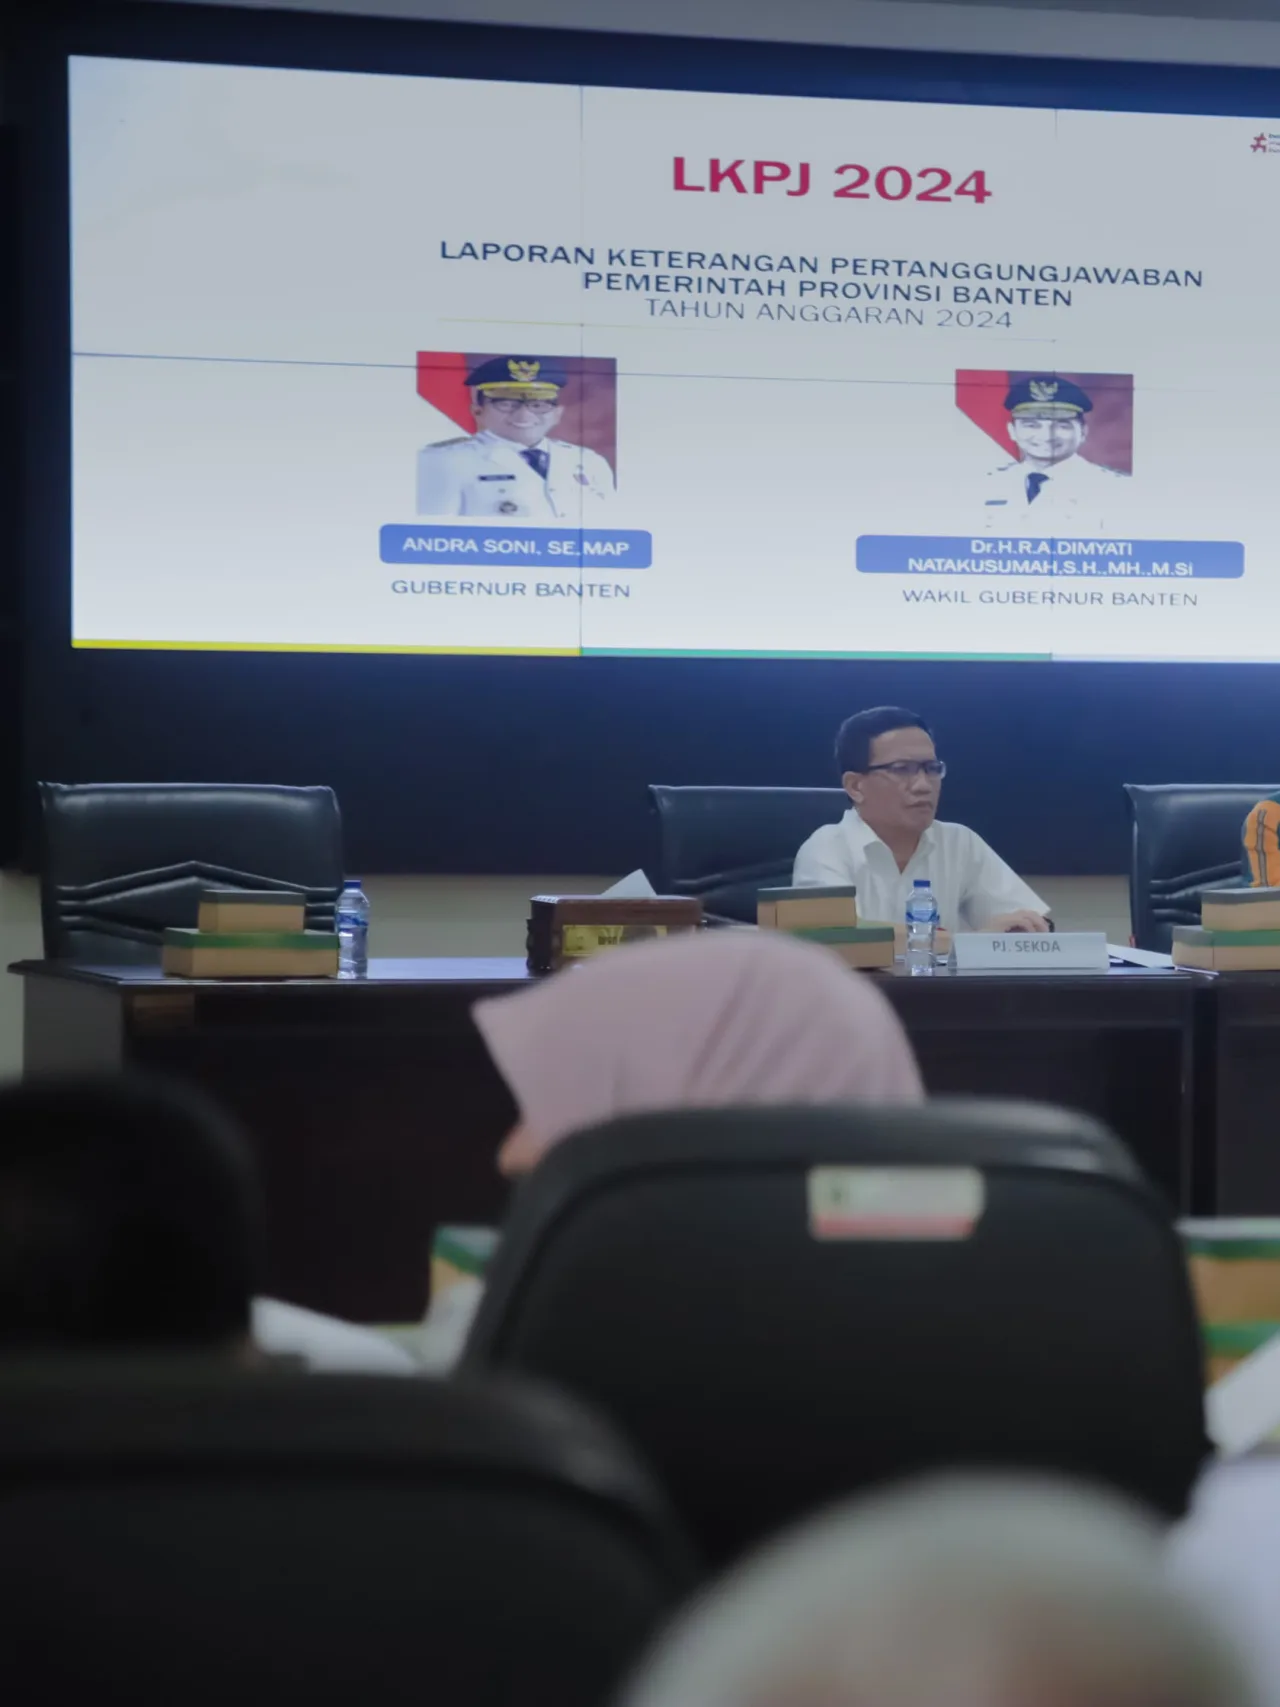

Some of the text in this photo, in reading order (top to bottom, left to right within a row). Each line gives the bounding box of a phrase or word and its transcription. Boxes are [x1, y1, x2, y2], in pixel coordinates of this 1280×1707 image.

[673, 156, 993, 204] LKPJ 2024
[440, 241, 1203, 288] LAPORAN KETERANGAN PERTANGGUNGJAWABAN
[583, 271, 1073, 307] PEMERINTAH PROVINSI BANTEN
[646, 298, 1013, 329] TAHUN ANGGARAN 2024
[402, 537, 479, 553] ANDRA
[390, 579, 631, 599] GUBERNUR BANTEN
[902, 589, 1199, 607] WAKIL GUBERNUR BANTEN
[1014, 940, 1062, 953] SEKDA
